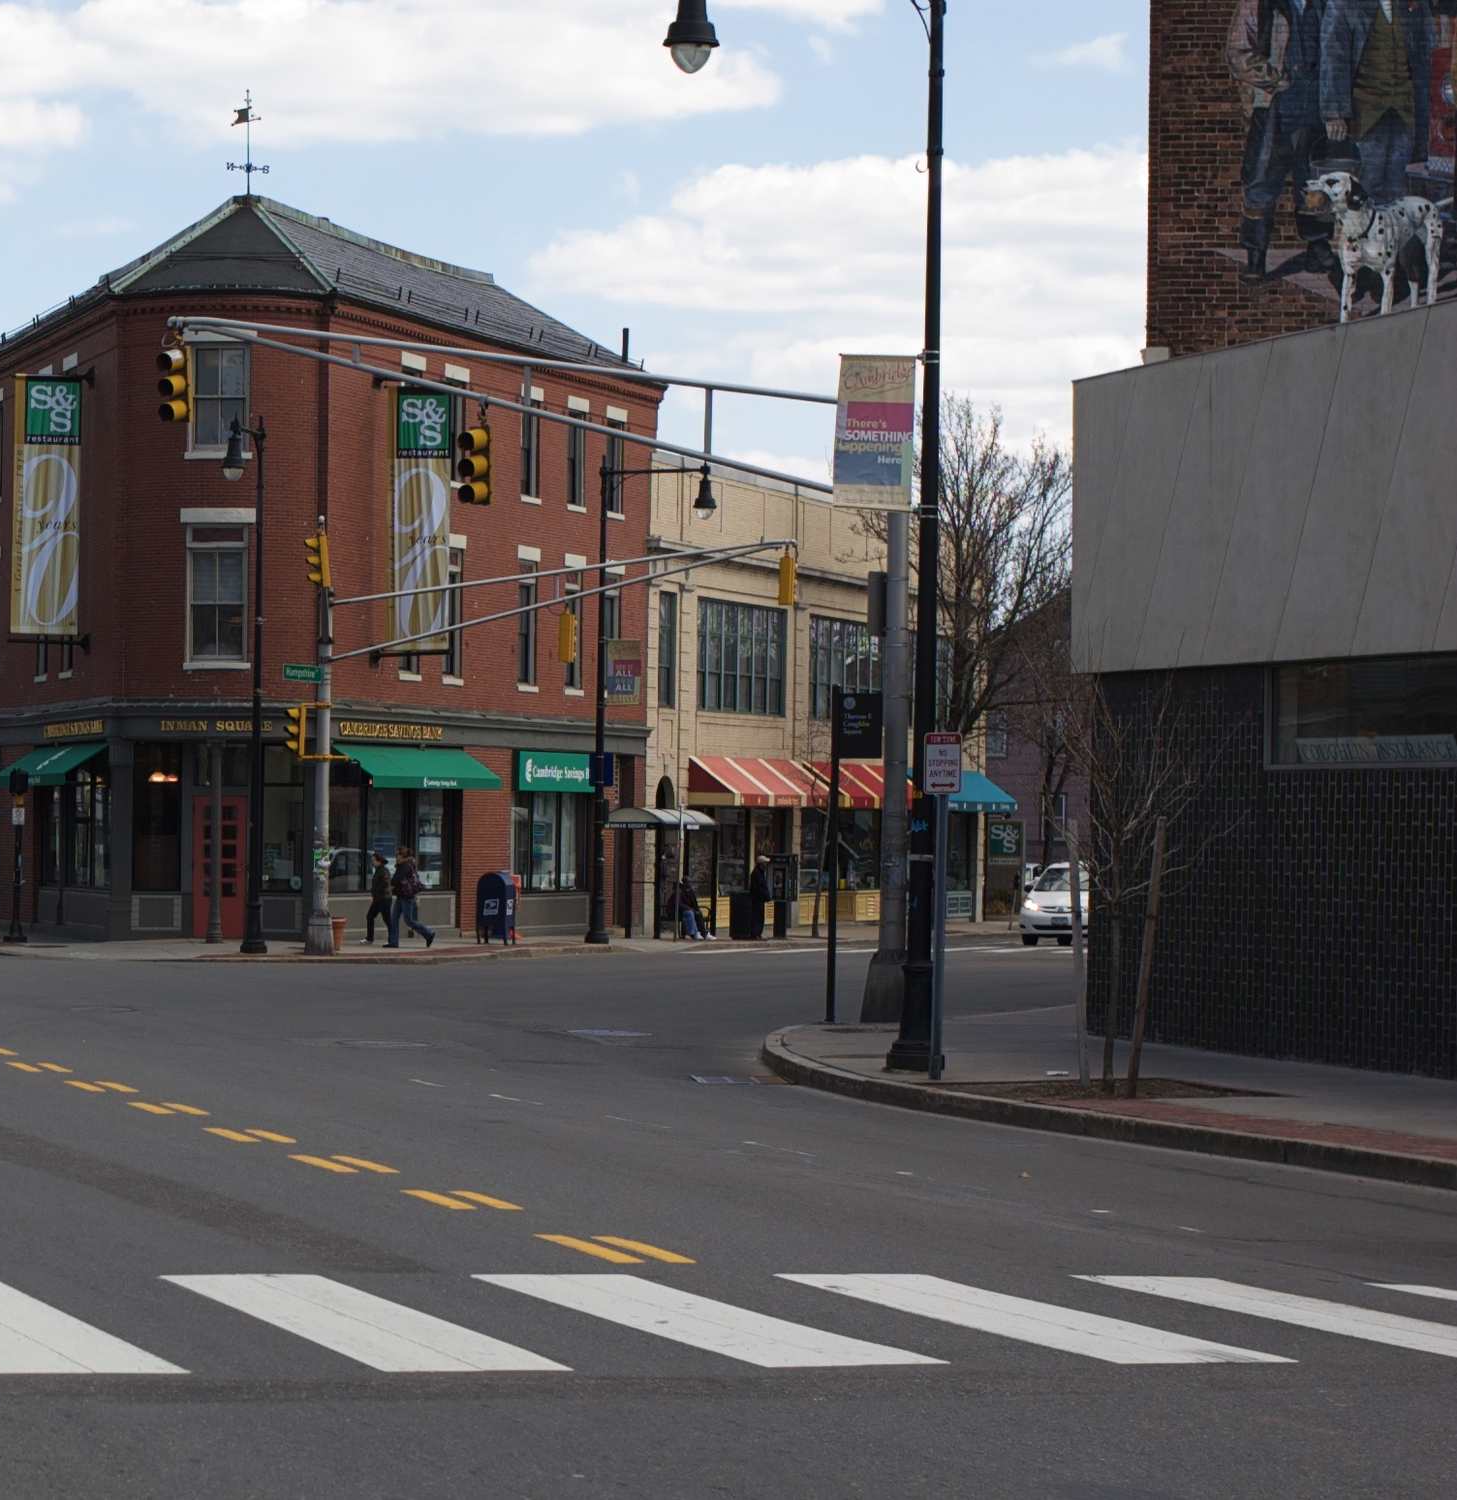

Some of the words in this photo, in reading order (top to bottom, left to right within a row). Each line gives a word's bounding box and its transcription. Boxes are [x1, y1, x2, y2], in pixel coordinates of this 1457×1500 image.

[847, 418, 887, 428] There's
[845, 430, 913, 442] SOMETHING
[398, 449, 449, 457] restaurant
[877, 455, 902, 464] Here
[160, 720, 208, 731] INMAN
[215, 720, 272, 732] SQUAE
[340, 721, 388, 737] CAMBRIDGE
[389, 724, 422, 738] SAVINGS
[532, 766, 563, 782] Cambridge
[564, 767, 585, 783] Savings
